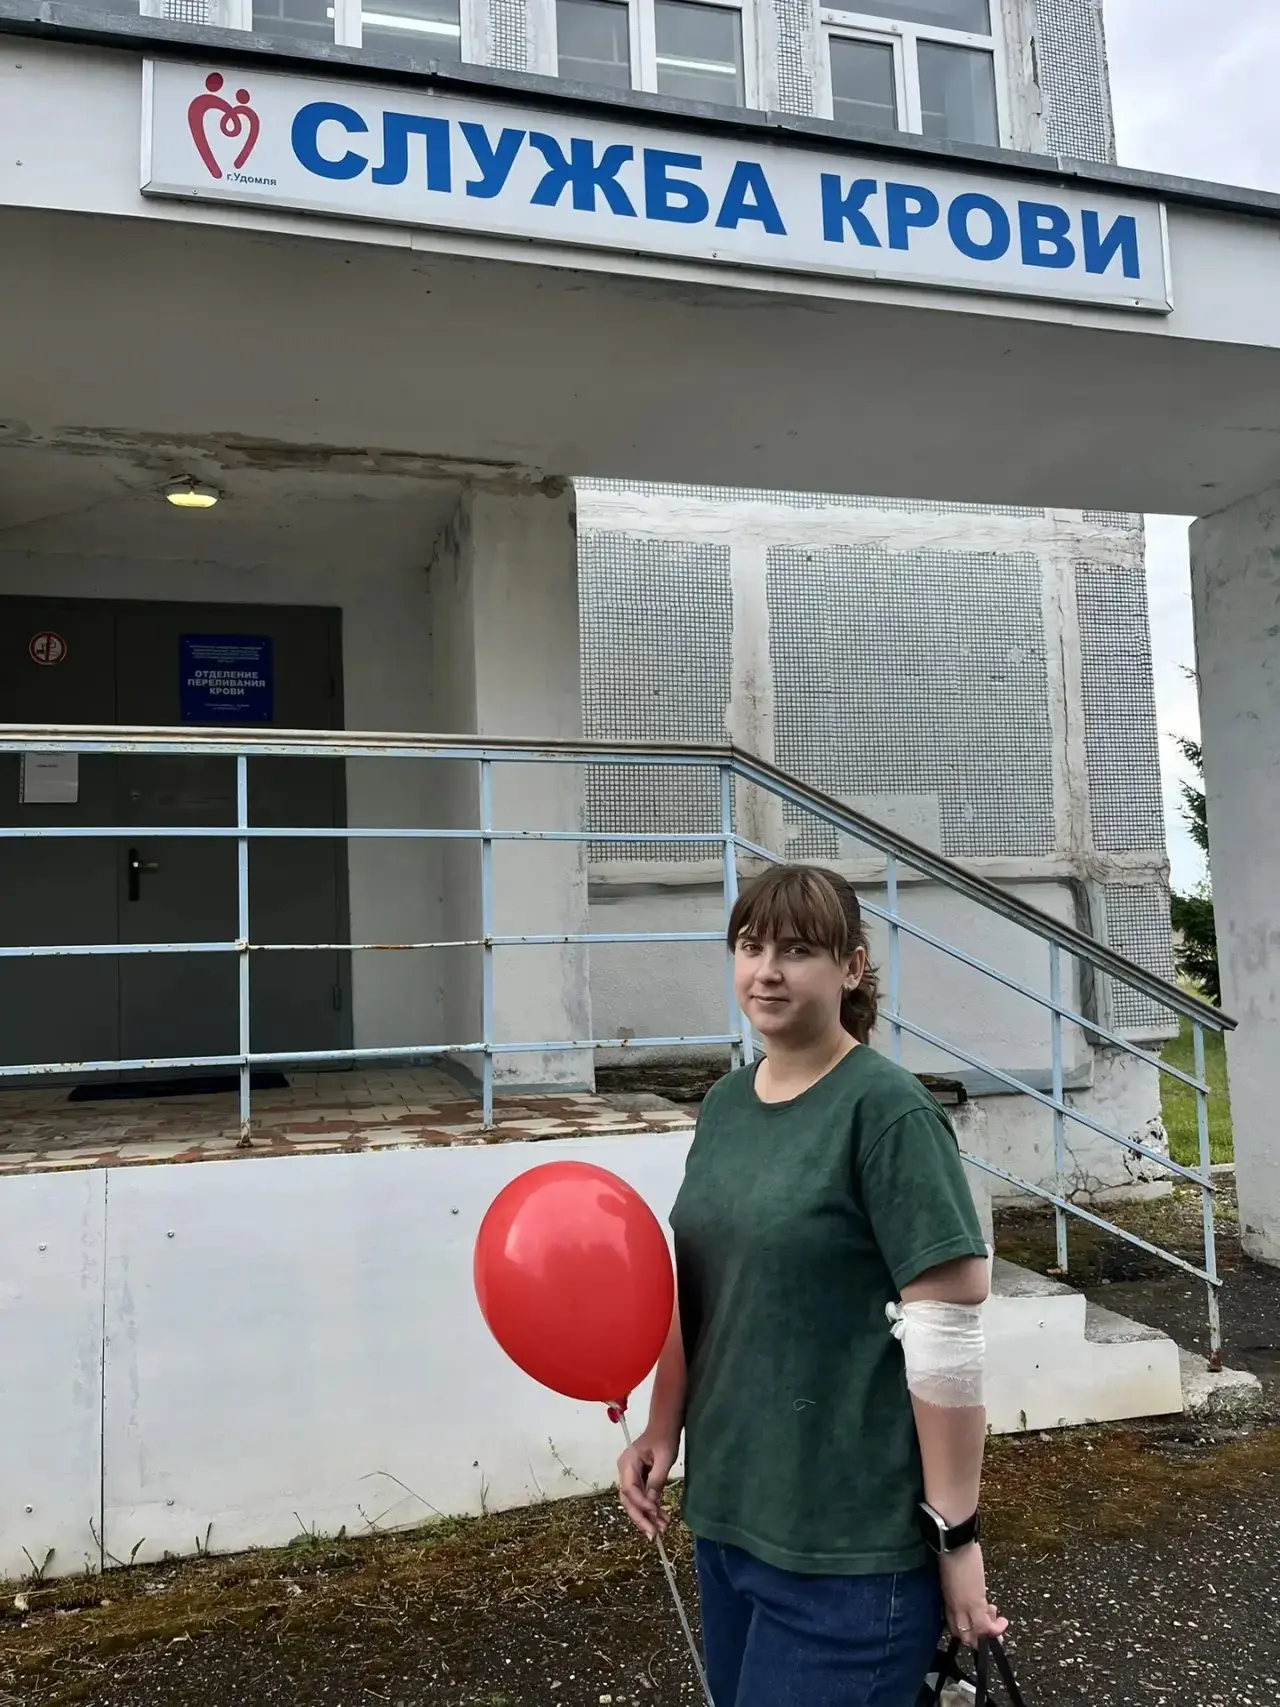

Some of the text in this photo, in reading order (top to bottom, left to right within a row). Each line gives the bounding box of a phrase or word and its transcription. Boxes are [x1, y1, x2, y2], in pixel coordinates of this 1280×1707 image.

[227, 172, 277, 186] г.Удомля
[290, 102, 1141, 281] СЛУЖБА КРОВИ
[194, 670, 259, 680] ОТДЕЛЕНИЕ
[187, 678, 266, 688] ПЕРЕЛИВАНИЯ
[209, 687, 245, 695] КРОВИ
